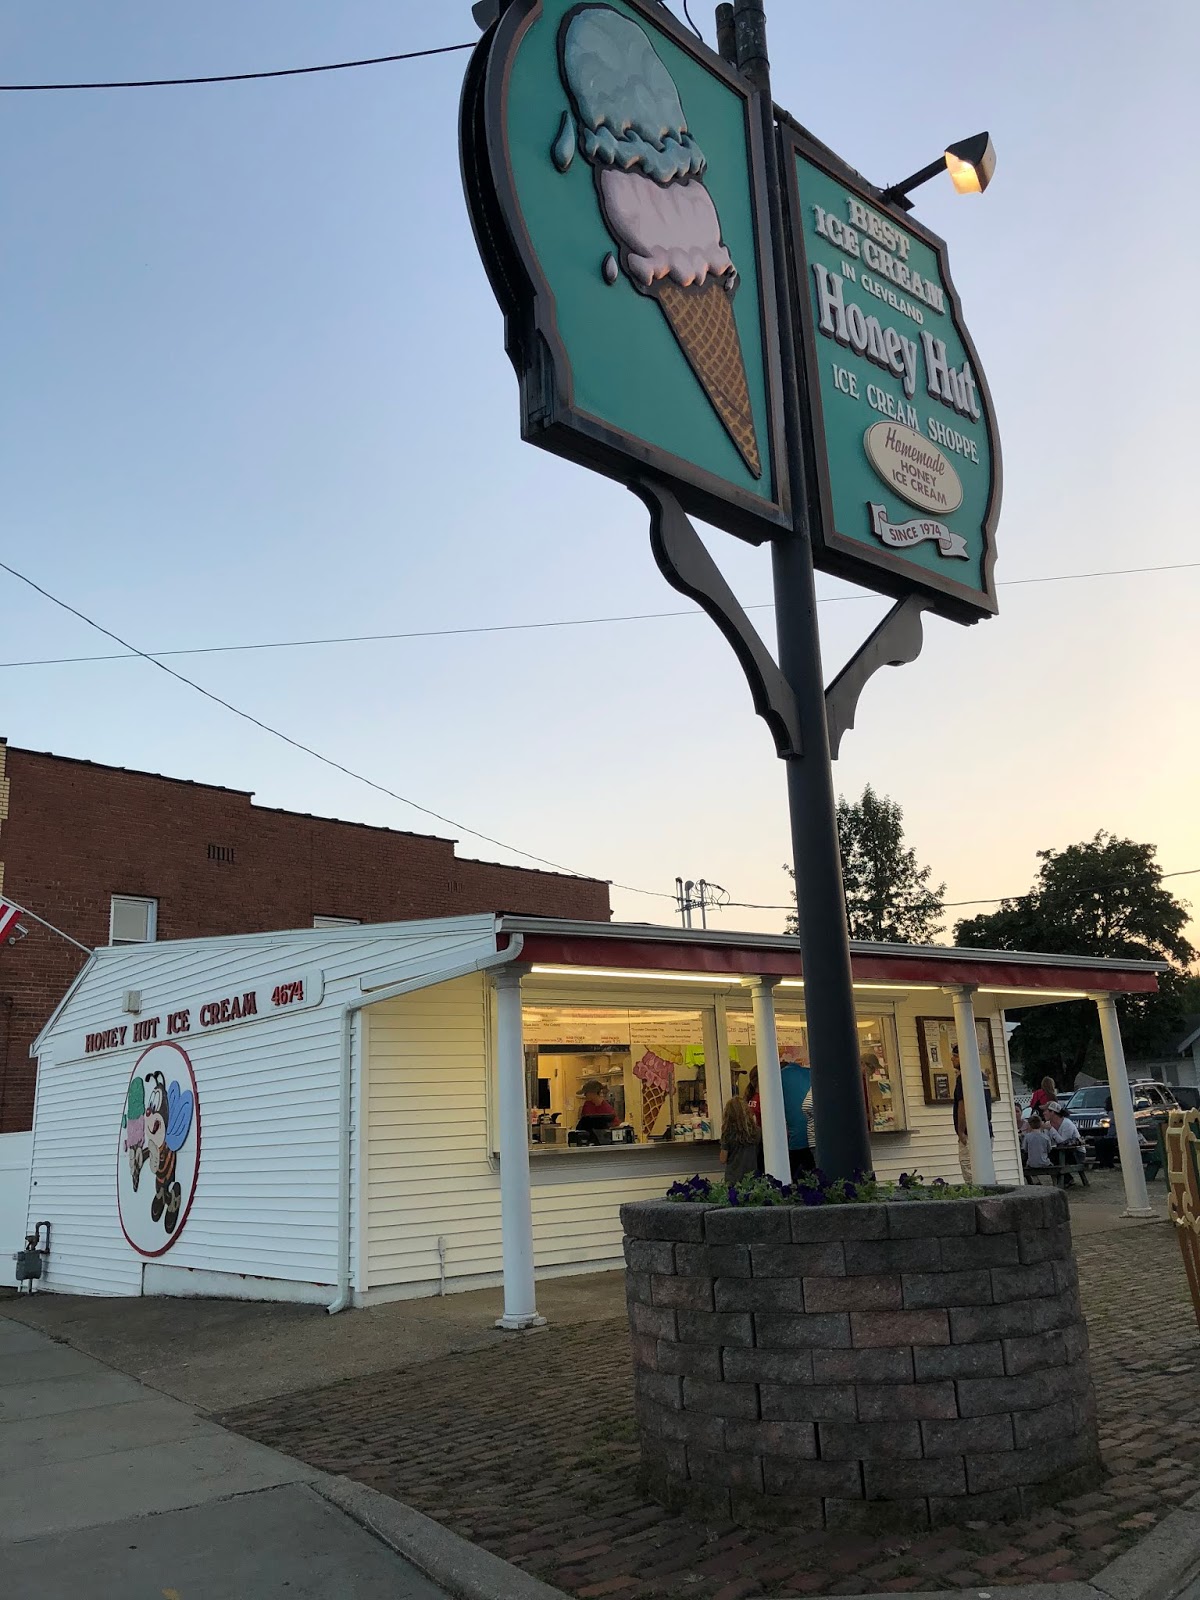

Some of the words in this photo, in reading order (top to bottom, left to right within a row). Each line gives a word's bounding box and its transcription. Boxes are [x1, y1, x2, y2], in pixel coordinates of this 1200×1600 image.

[811, 204, 860, 260] ICE
[860, 238, 946, 316] CREAM
[846, 197, 910, 262] BEST
[840, 260, 856, 283] IN
[860, 274, 924, 326] CLEVELAND
[812, 262, 917, 400] Honey
[919, 329, 981, 424] Hut
[831, 363, 860, 400] ICE
[866, 383, 920, 432] CREAM
[927, 417, 980, 465] SHOPPE
[884, 427, 945, 476] Homemade
[900, 459, 937, 487] HONEY
[892, 469, 908, 487] ICE
[911, 479, 948, 506] CREAM
[888, 526, 918, 541] SINCE
[920, 523, 942, 537] 1974
[84, 1026, 128, 1053] HONEY
[133, 1016, 160, 1043] HUT
[166, 1008, 191, 1035] ICE
[199, 991, 258, 1028] CREAM
[270, 980, 305, 1007] 4674
